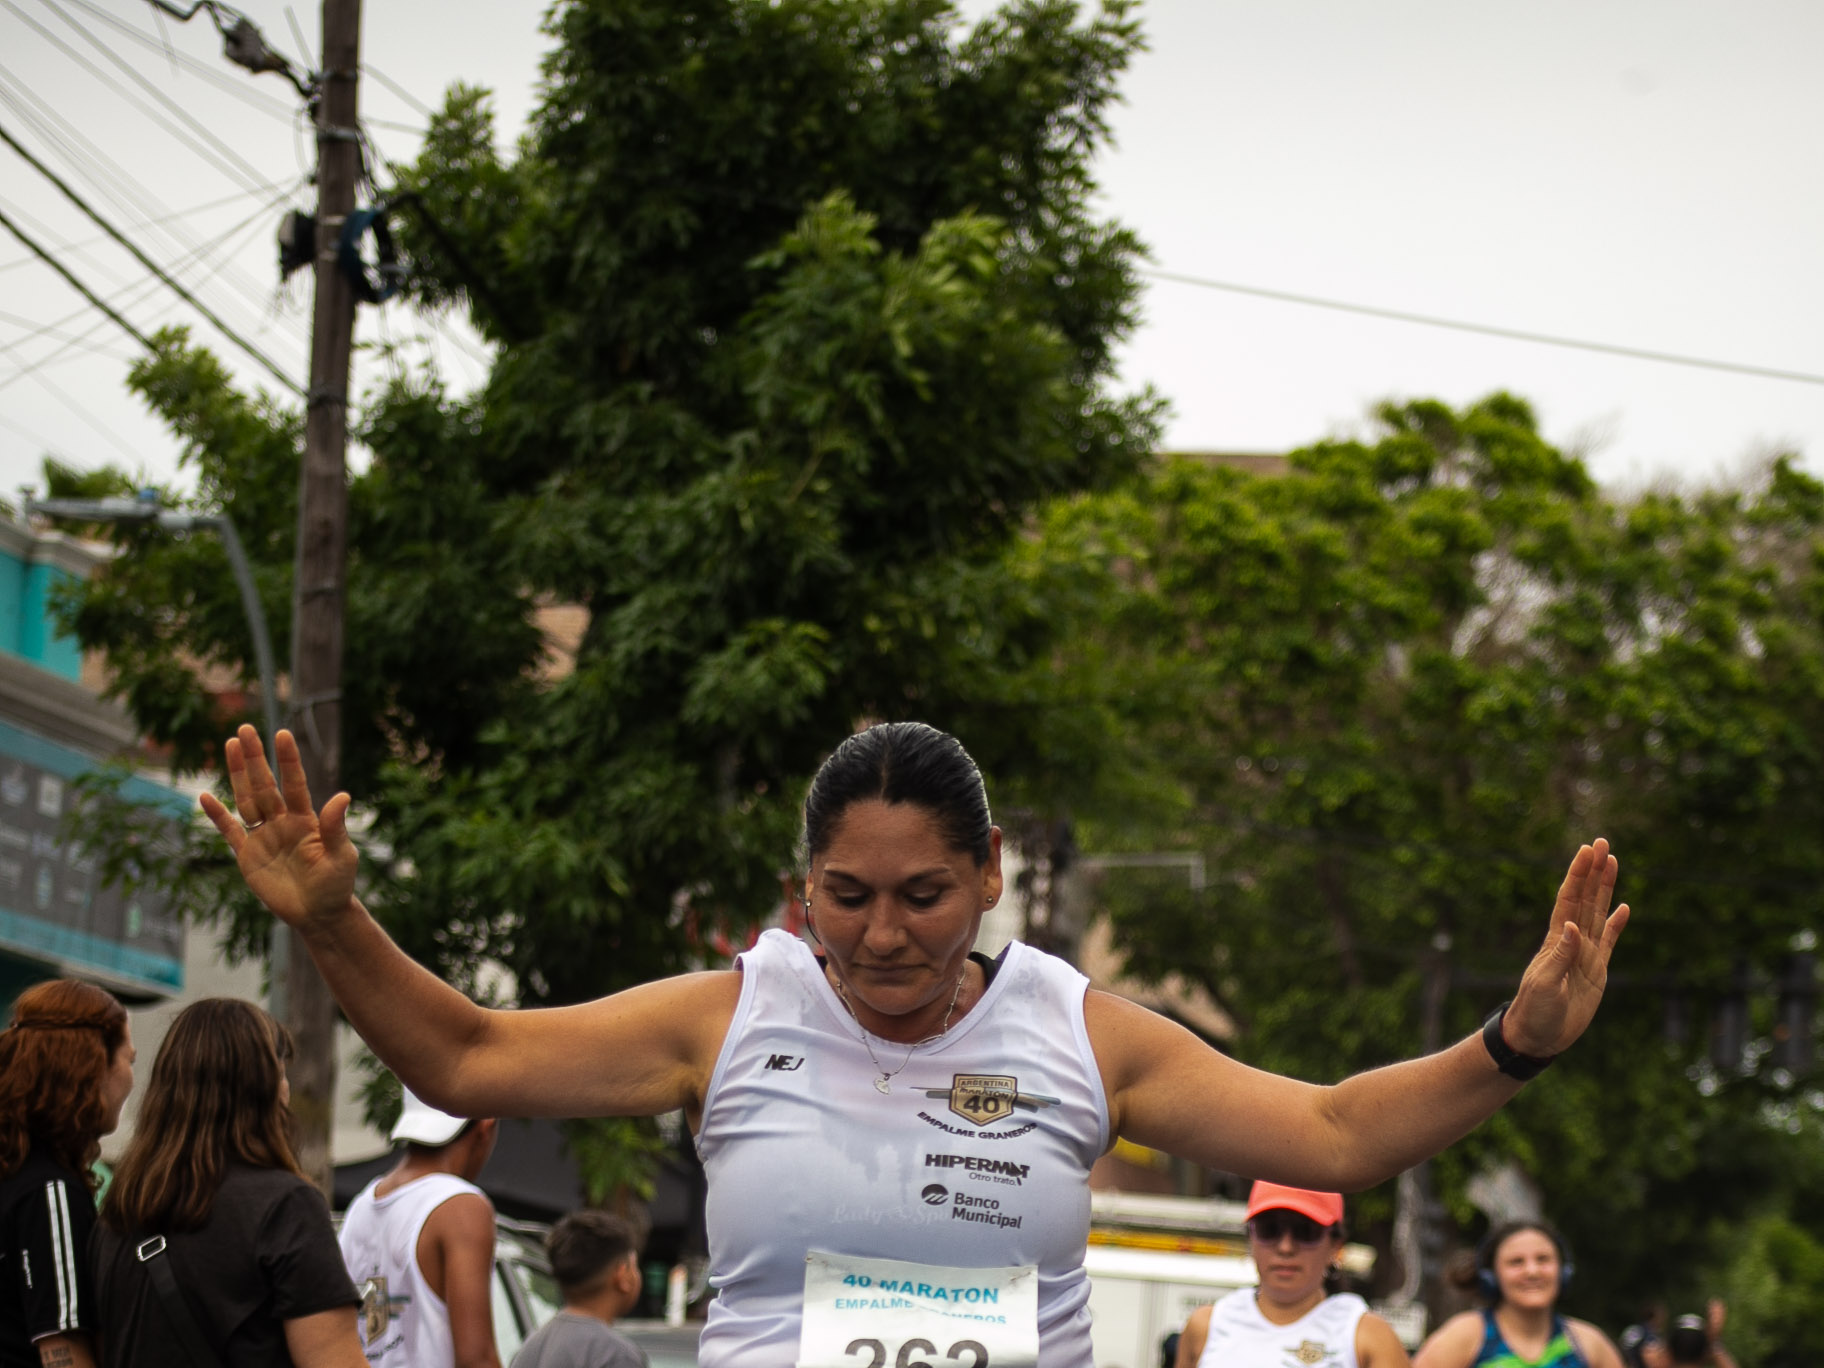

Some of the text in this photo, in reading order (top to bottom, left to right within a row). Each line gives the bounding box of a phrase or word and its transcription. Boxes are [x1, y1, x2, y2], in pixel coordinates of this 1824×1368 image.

[963, 1095, 1000, 1114] 40
[917, 1112, 1038, 1140] EMPALME GRANEROS
[969, 1172, 991, 1182] Otro
[954, 1192, 1000, 1210] Banco
[952, 1207, 1023, 1230] Municipal
[843, 1274, 999, 1304] 40 MARATON
[835, 1298, 914, 1310] EMPALME
